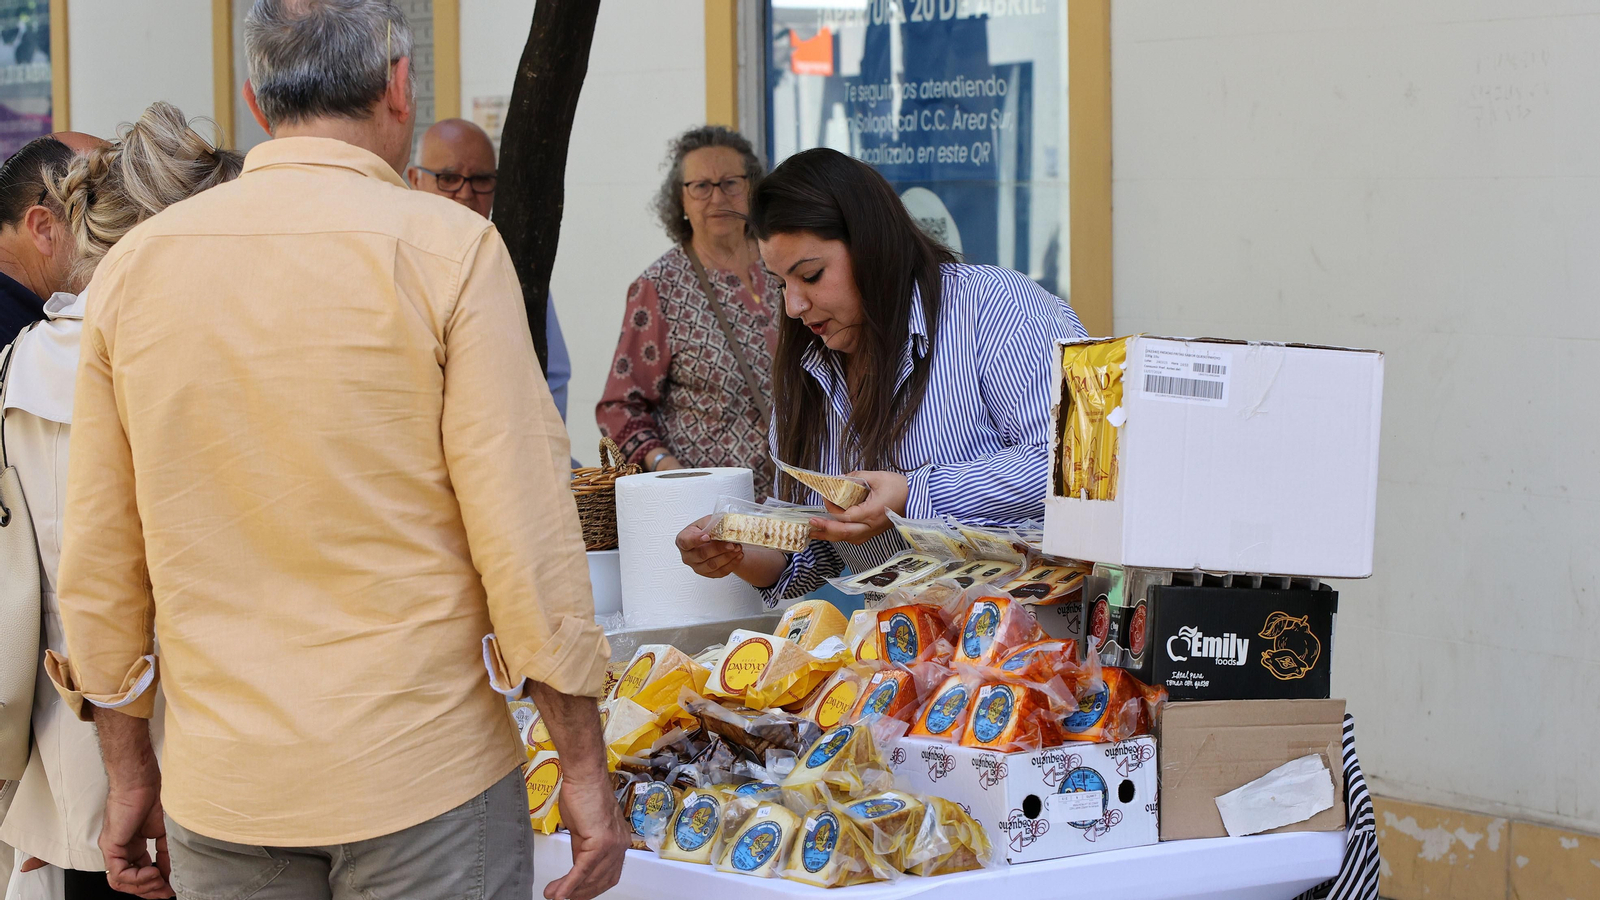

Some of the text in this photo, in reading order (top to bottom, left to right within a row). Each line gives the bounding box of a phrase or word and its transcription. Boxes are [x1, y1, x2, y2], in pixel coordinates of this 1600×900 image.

[910, 0, 935, 23] 20
[939, 0, 971, 20] DE
[844, 74, 1007, 108] Te seguios atendiendo
[856, 109, 918, 138] Soloptcal
[920, 109, 949, 131] C.C.
[952, 104, 988, 131] Área
[858, 141, 991, 166] ocalízalo en este QR
[1191, 631, 1250, 666] Emily
[1215, 657, 1237, 666] foods
[1172, 671, 1204, 681] Ideal para
